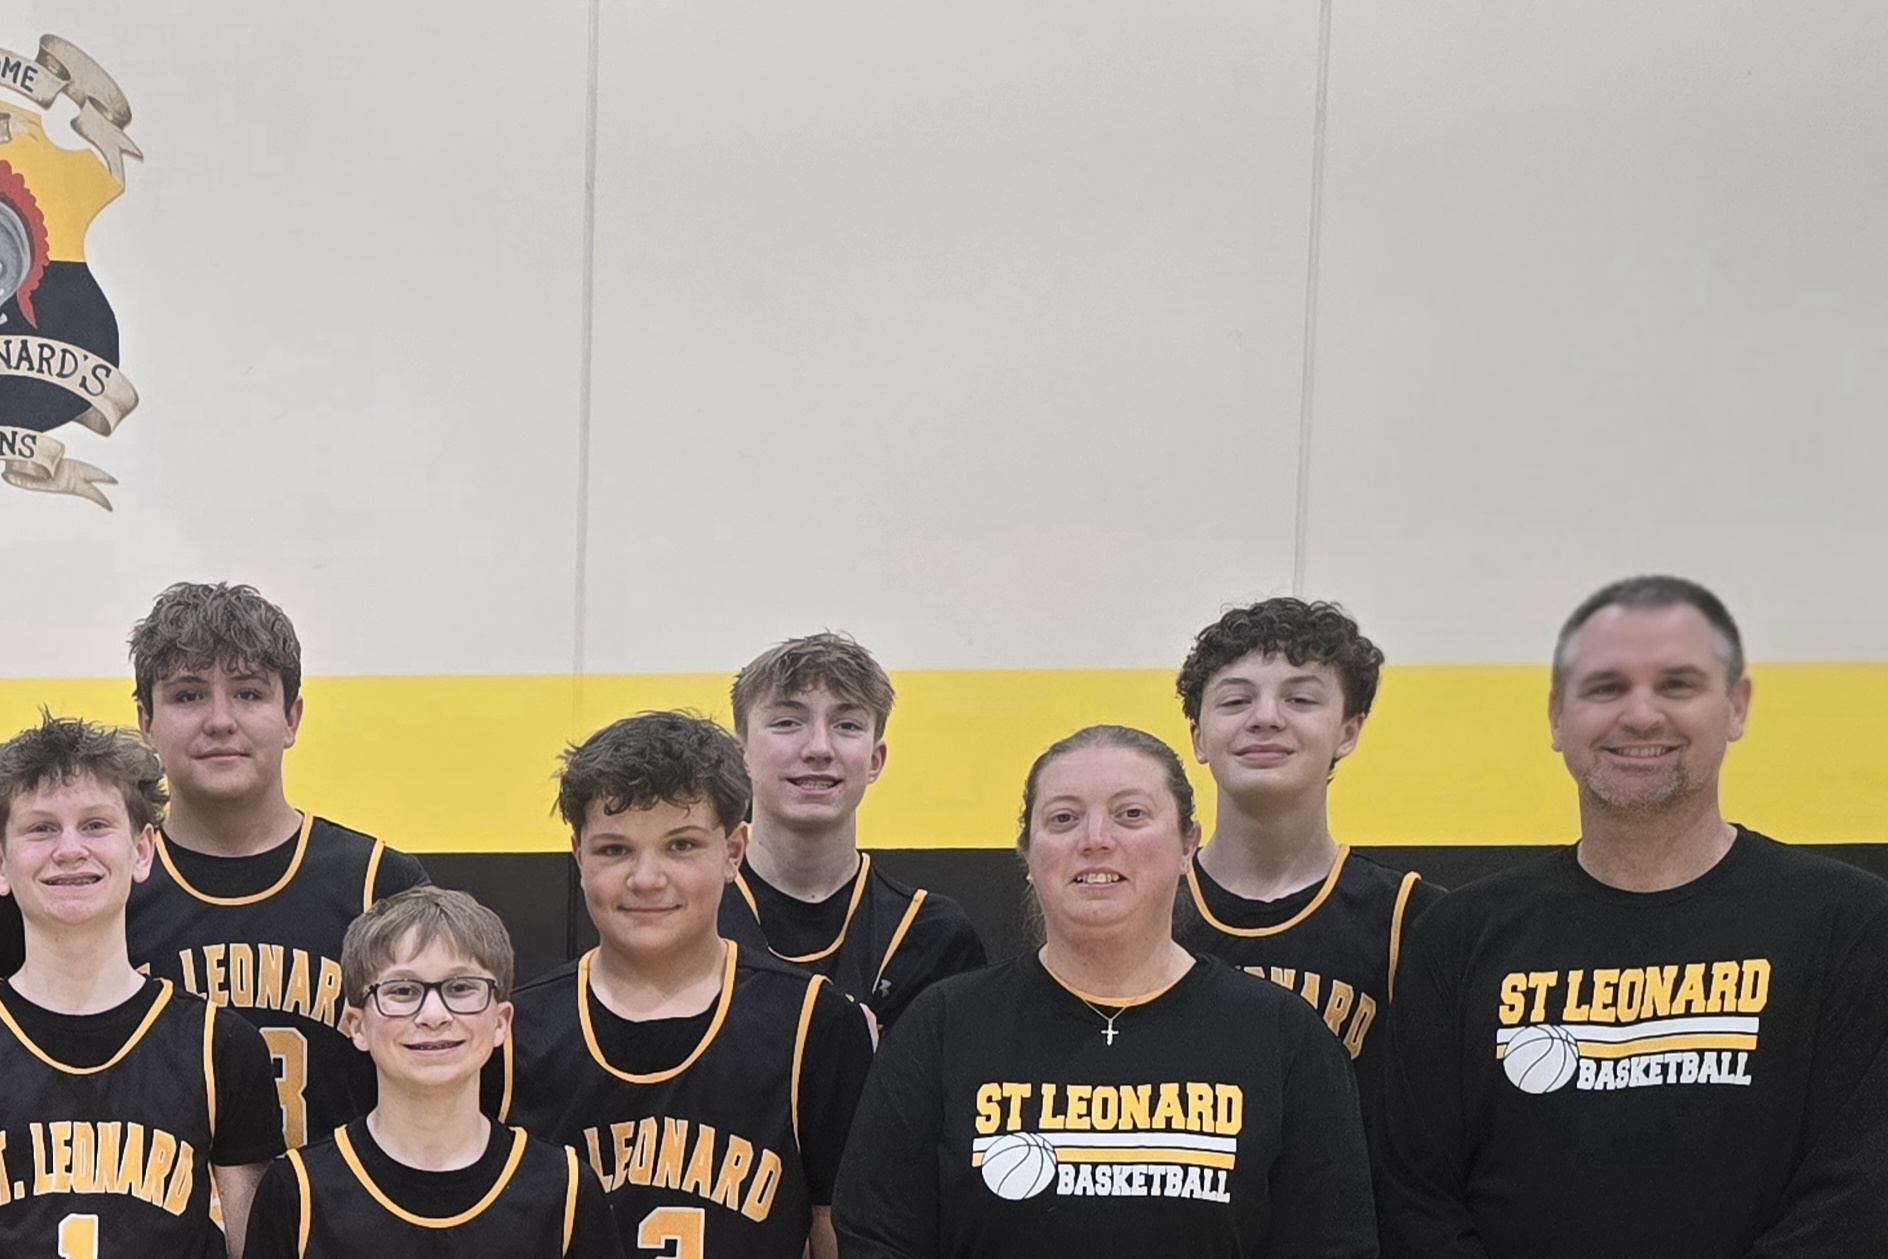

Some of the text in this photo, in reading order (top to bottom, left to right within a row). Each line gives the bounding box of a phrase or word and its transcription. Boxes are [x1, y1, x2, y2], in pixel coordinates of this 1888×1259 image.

[179, 943, 352, 1038] LEONAR
[1498, 958, 1771, 1025] ST LEONARD
[1576, 1051, 1752, 1091] BASKETBALL
[975, 1081, 1244, 1136] ST LEONARD
[29, 1121, 195, 1217] LEONARD
[583, 1116, 783, 1223] LEONARD
[1056, 1163, 1231, 1204] BASKETBALL
